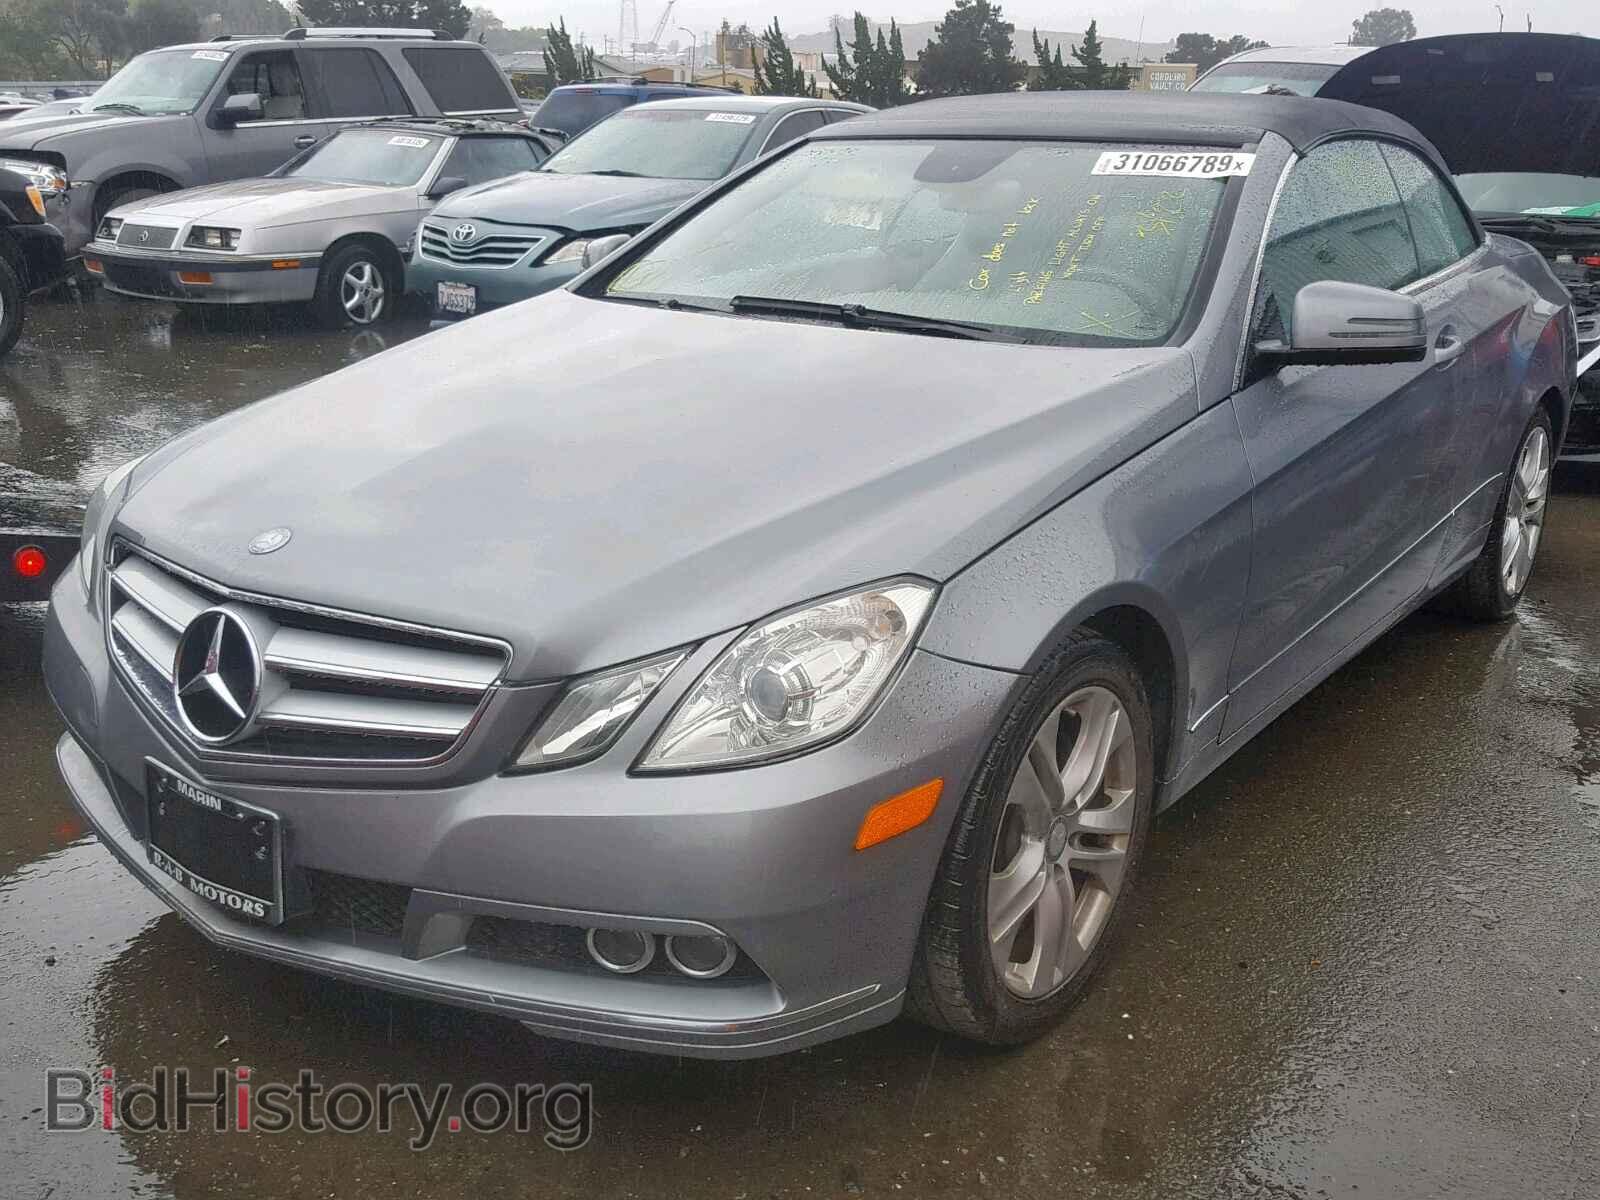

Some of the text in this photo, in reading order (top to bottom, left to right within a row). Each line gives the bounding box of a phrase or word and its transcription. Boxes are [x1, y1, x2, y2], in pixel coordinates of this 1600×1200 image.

[1113, 154, 1234, 174] 31066789
[177, 779, 222, 811] MARIN
[190, 878, 265, 917] MOTORS
